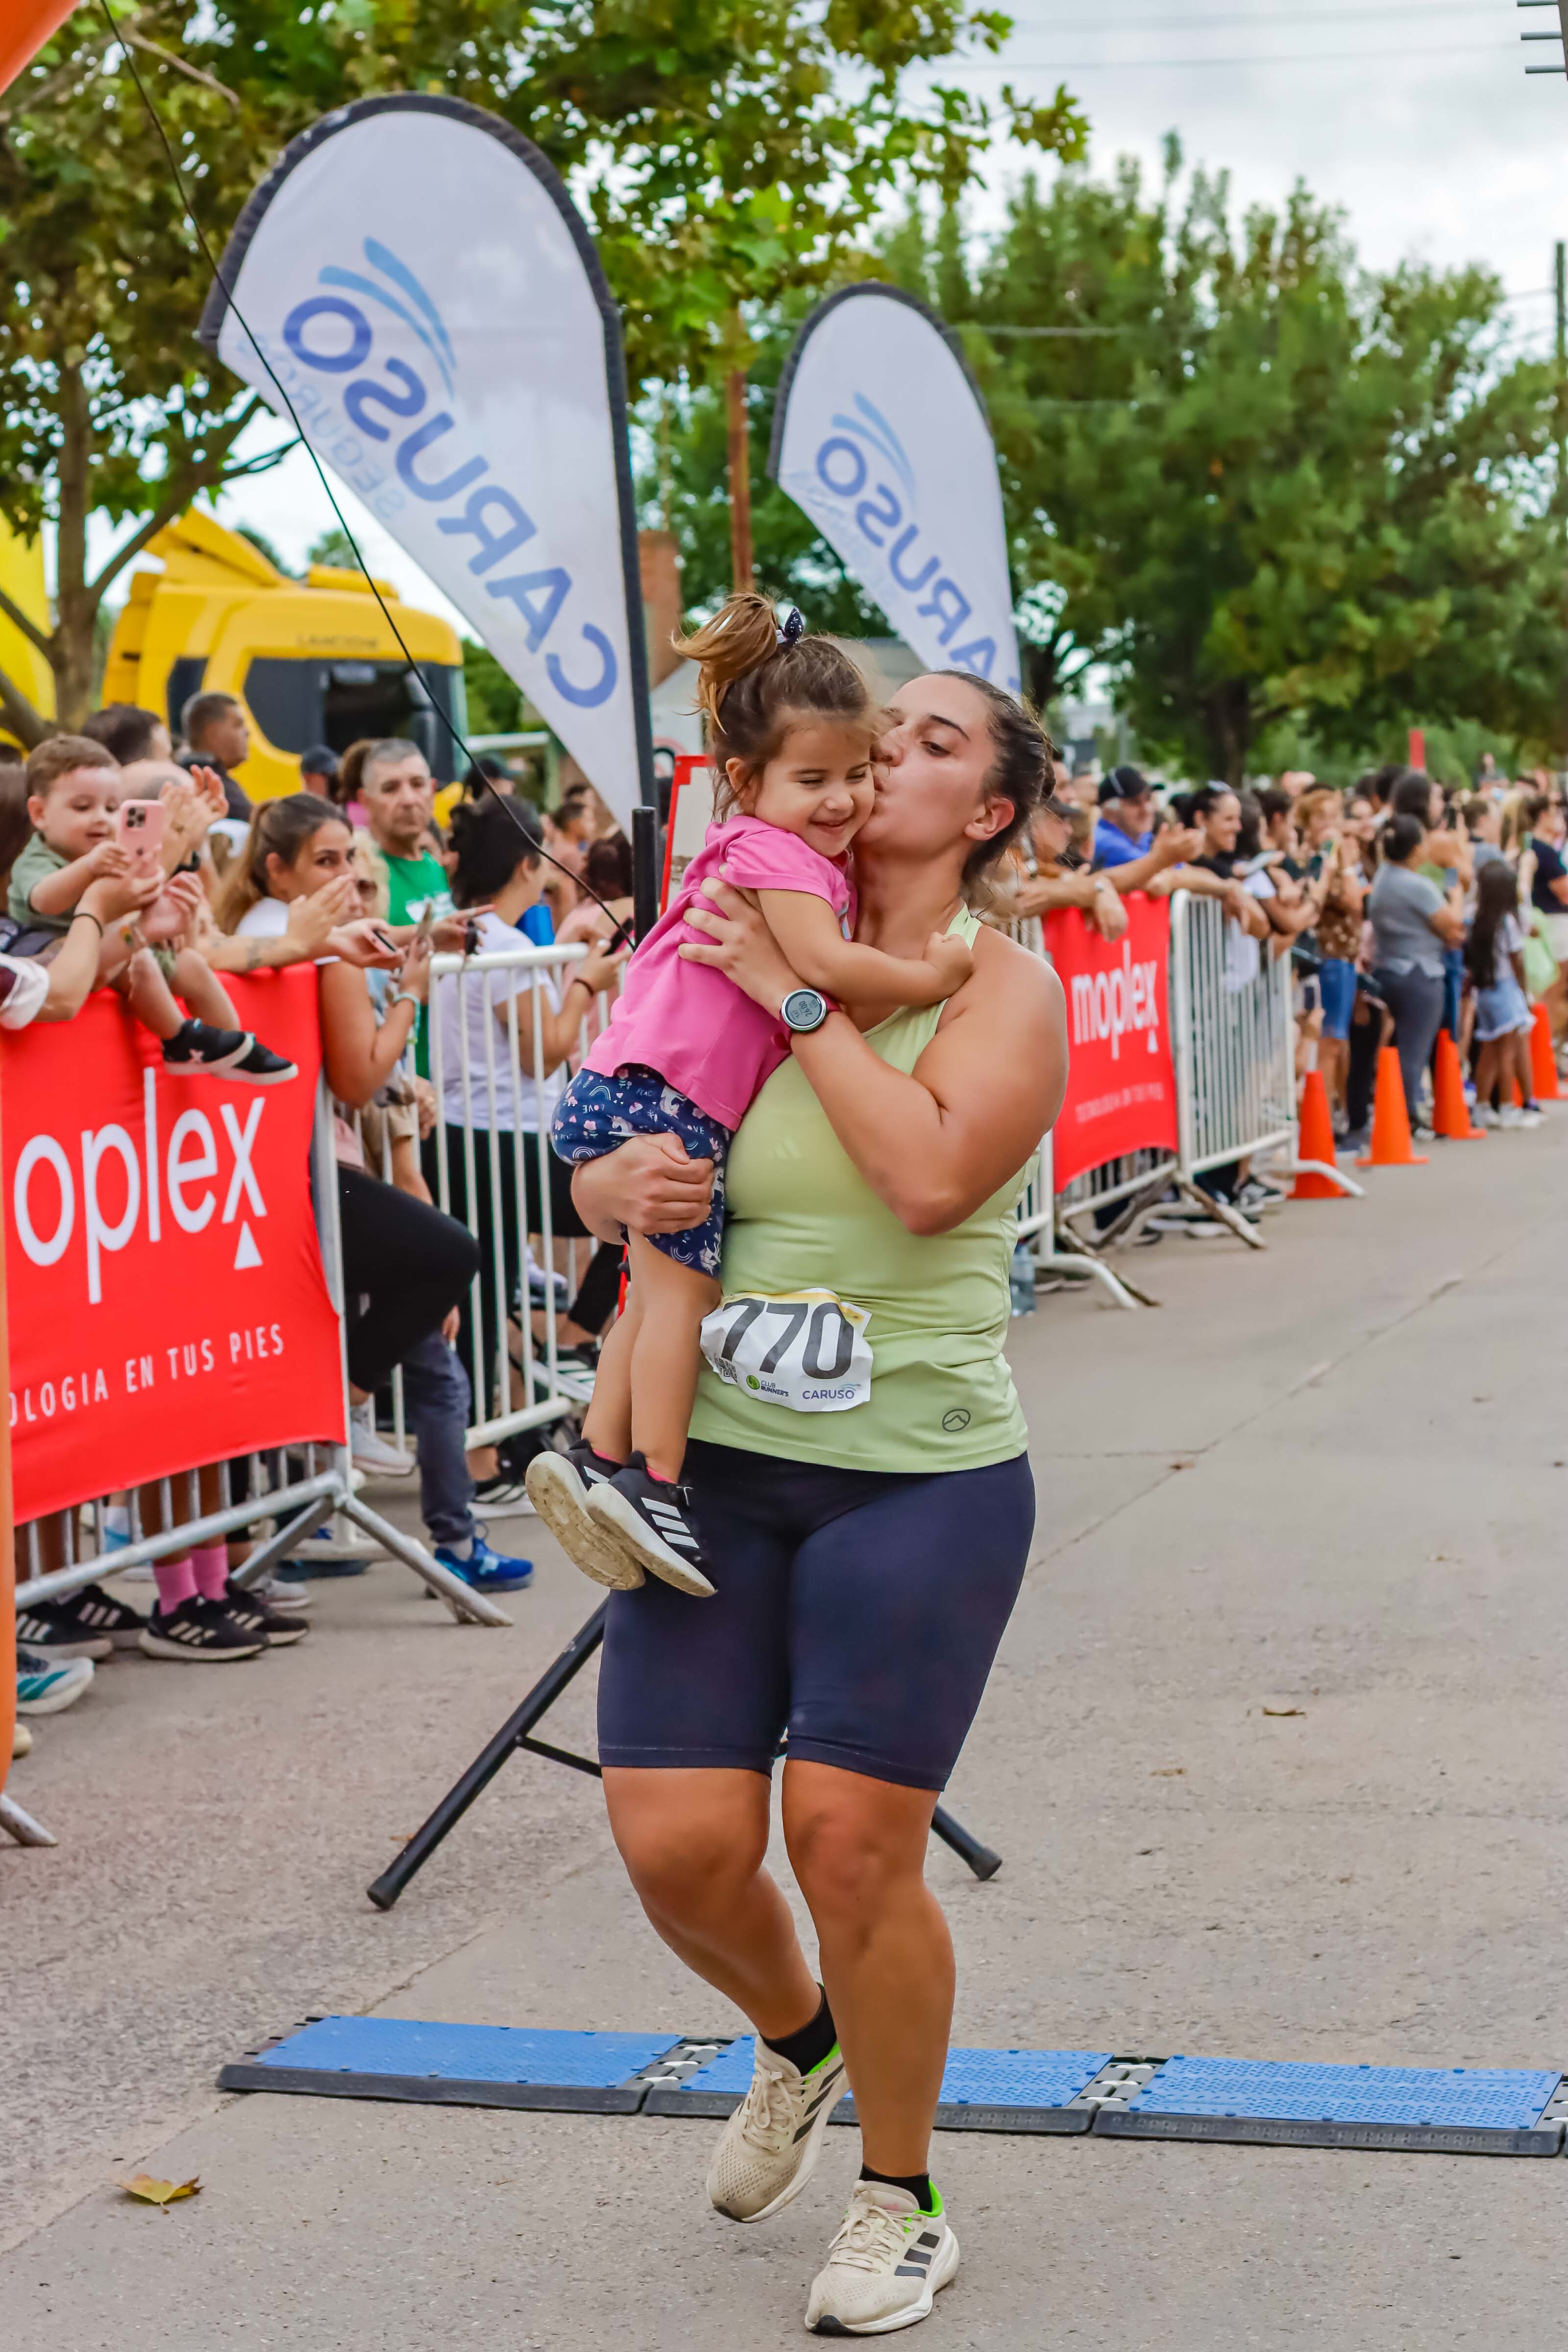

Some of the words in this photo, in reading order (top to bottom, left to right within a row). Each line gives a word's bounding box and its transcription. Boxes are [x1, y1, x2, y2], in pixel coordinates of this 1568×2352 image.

[1071, 940, 1159, 1060] moplex
[14, 1067, 267, 1304] oplex
[125, 1355, 154, 1393] EN
[167, 1339, 214, 1380] TUS
[229, 1323, 284, 1364] PIES
[722, 1298, 854, 1379] 770
[761, 1380, 776, 1388] CLUB
[802, 1390, 855, 1399] CARUSO
